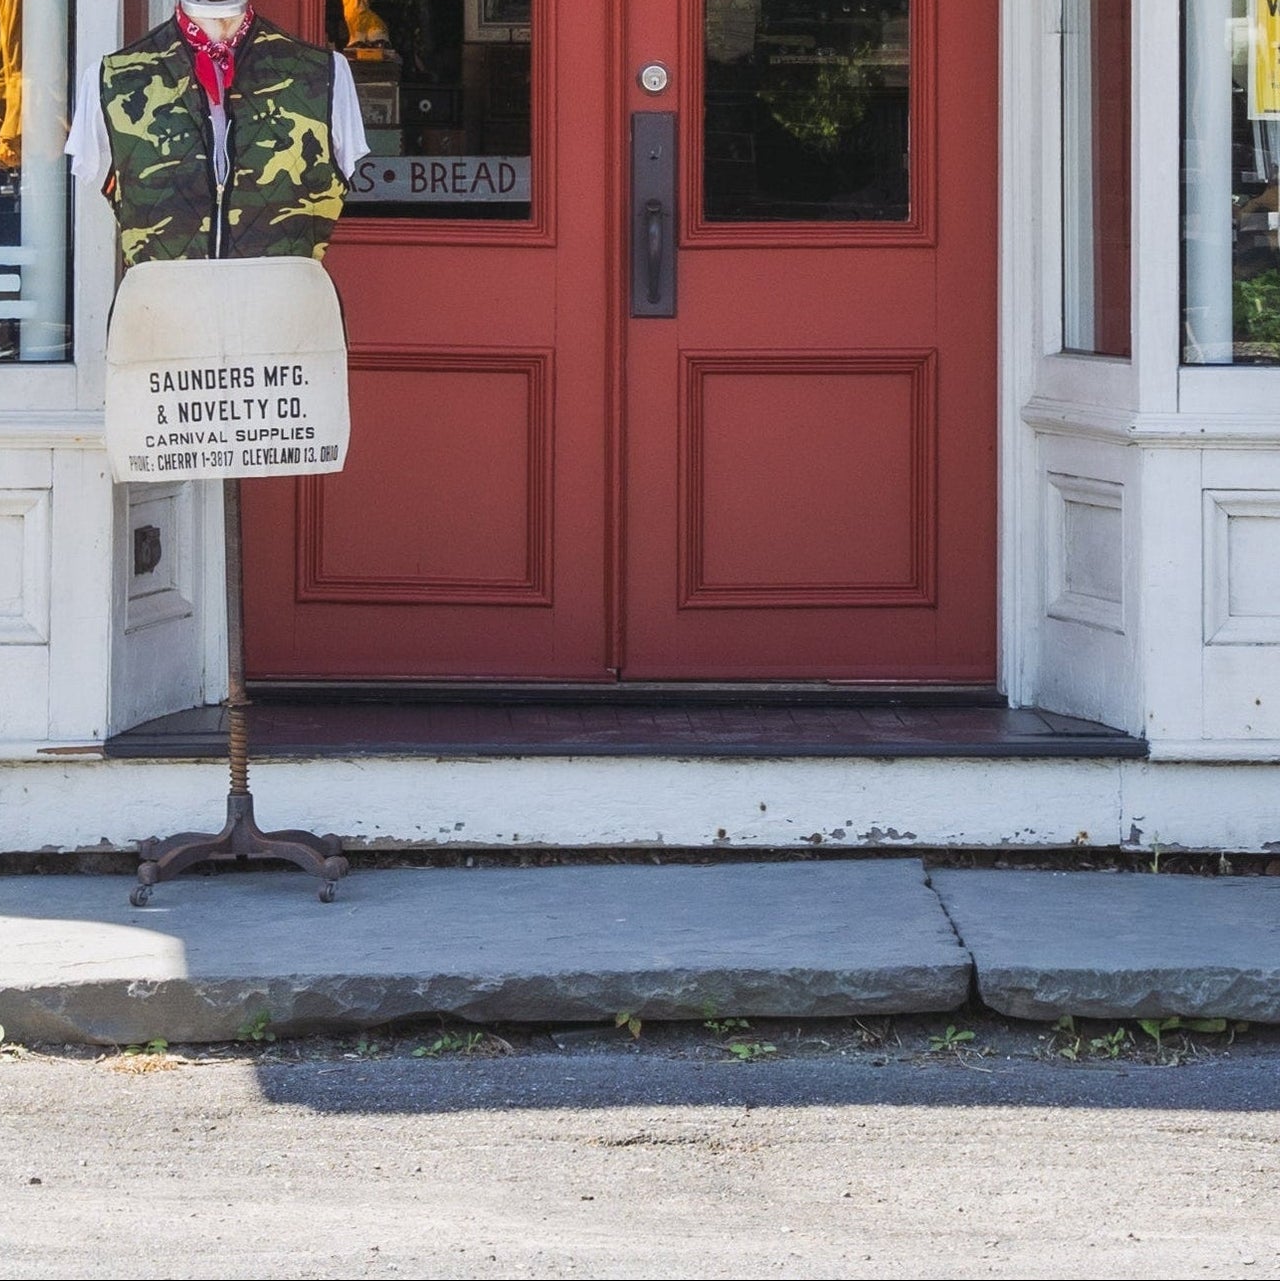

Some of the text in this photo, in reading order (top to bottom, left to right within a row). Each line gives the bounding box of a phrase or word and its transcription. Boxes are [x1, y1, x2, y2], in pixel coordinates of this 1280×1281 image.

[410, 163, 516, 194] BREAD
[150, 365, 308, 393] SAUNDERS MFG.
[158, 397, 307, 424] & NOVELTY CO.
[146, 427, 315, 448] CARNIVAL SUPPLIES
[129, 455, 154, 472] PHONE:
[158, 452, 197, 471] CHERRY
[202, 451, 234, 468] 1-3817
[243, 447, 301, 466] CLEVELAND
[320, 444, 339, 462] OHIO
